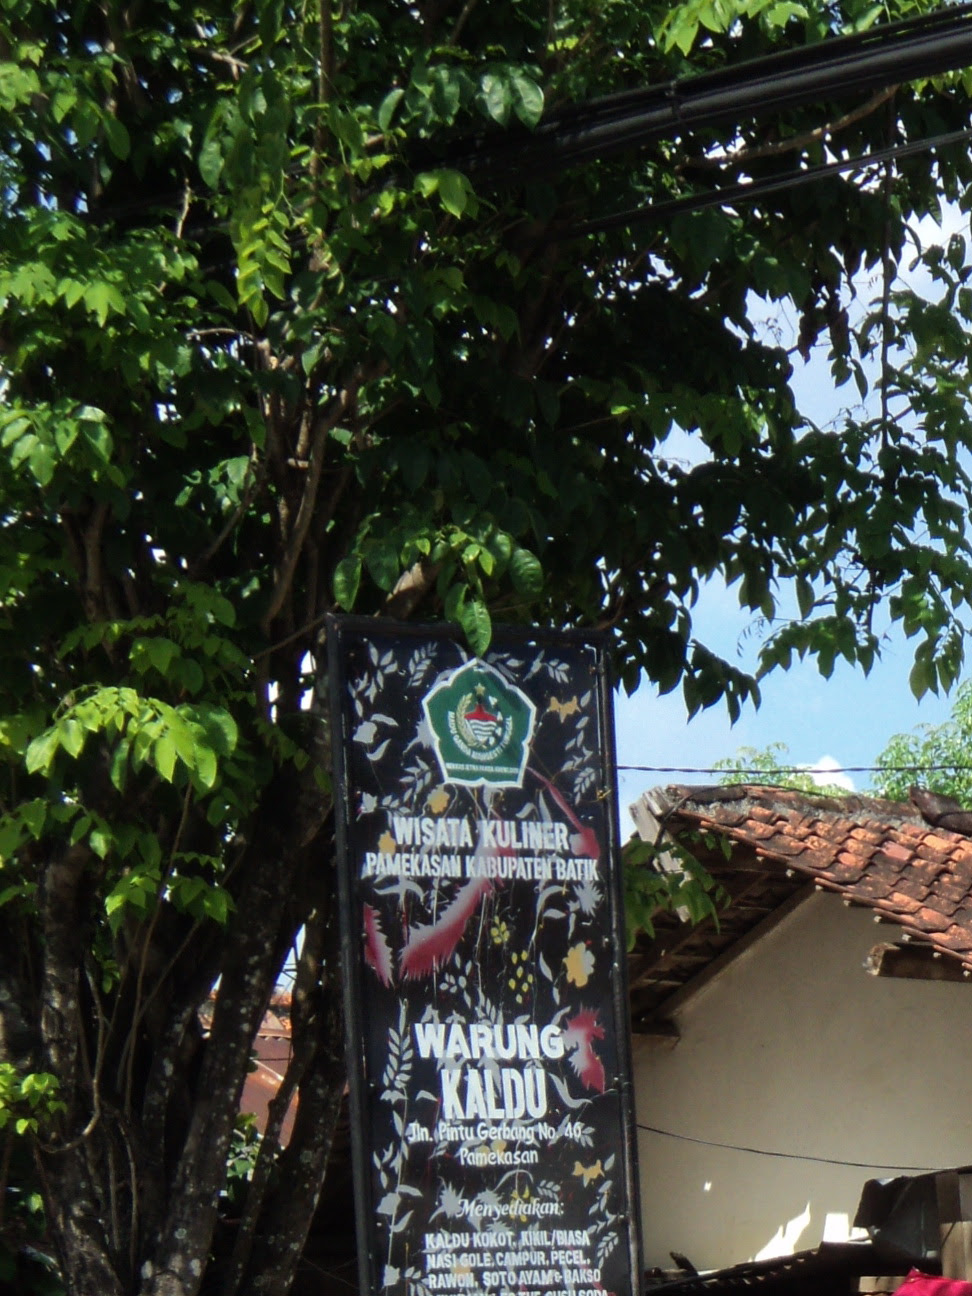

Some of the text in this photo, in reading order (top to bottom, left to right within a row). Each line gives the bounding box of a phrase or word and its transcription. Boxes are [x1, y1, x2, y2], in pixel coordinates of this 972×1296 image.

[392, 817, 569, 850] WISATA KULINER
[366, 852, 599, 881] PAMEKASAN KABUPATEN BATIK
[415, 1023, 565, 1059] WARUNG
[441, 1068, 548, 1119] KALDU
[408, 1123, 433, 1142] Jln.
[439, 1122, 475, 1141] Pintu
[477, 1122, 535, 1145] Gerbang
[460, 1148, 539, 1166] Pamekasan
[455, 1198, 565, 1220] Menyediakan:
[425, 1232, 470, 1249] KALDU
[427, 1253, 456, 1269] NASI
[483, 1271, 516, 1287] SOTO
[519, 1270, 553, 1285] AYAM
[563, 1269, 601, 1284] BAKSO
